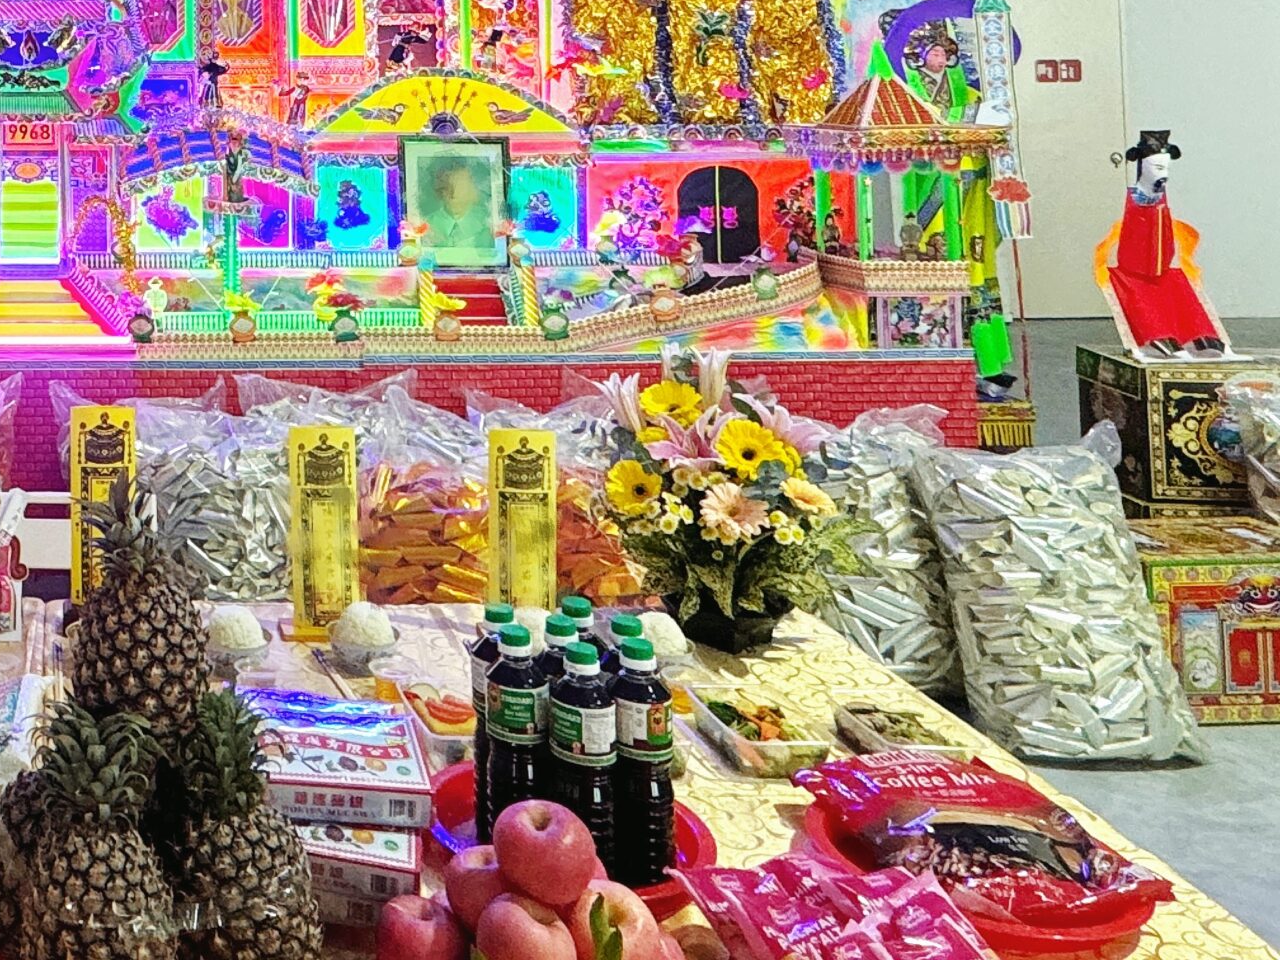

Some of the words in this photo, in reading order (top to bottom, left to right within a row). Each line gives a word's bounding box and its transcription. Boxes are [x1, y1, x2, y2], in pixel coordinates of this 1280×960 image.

[8, 123, 51, 140] 9968
[890, 763, 950, 775] 3-in-1
[873, 773, 947, 788] Coffee
[948, 772, 997, 787] Mix
